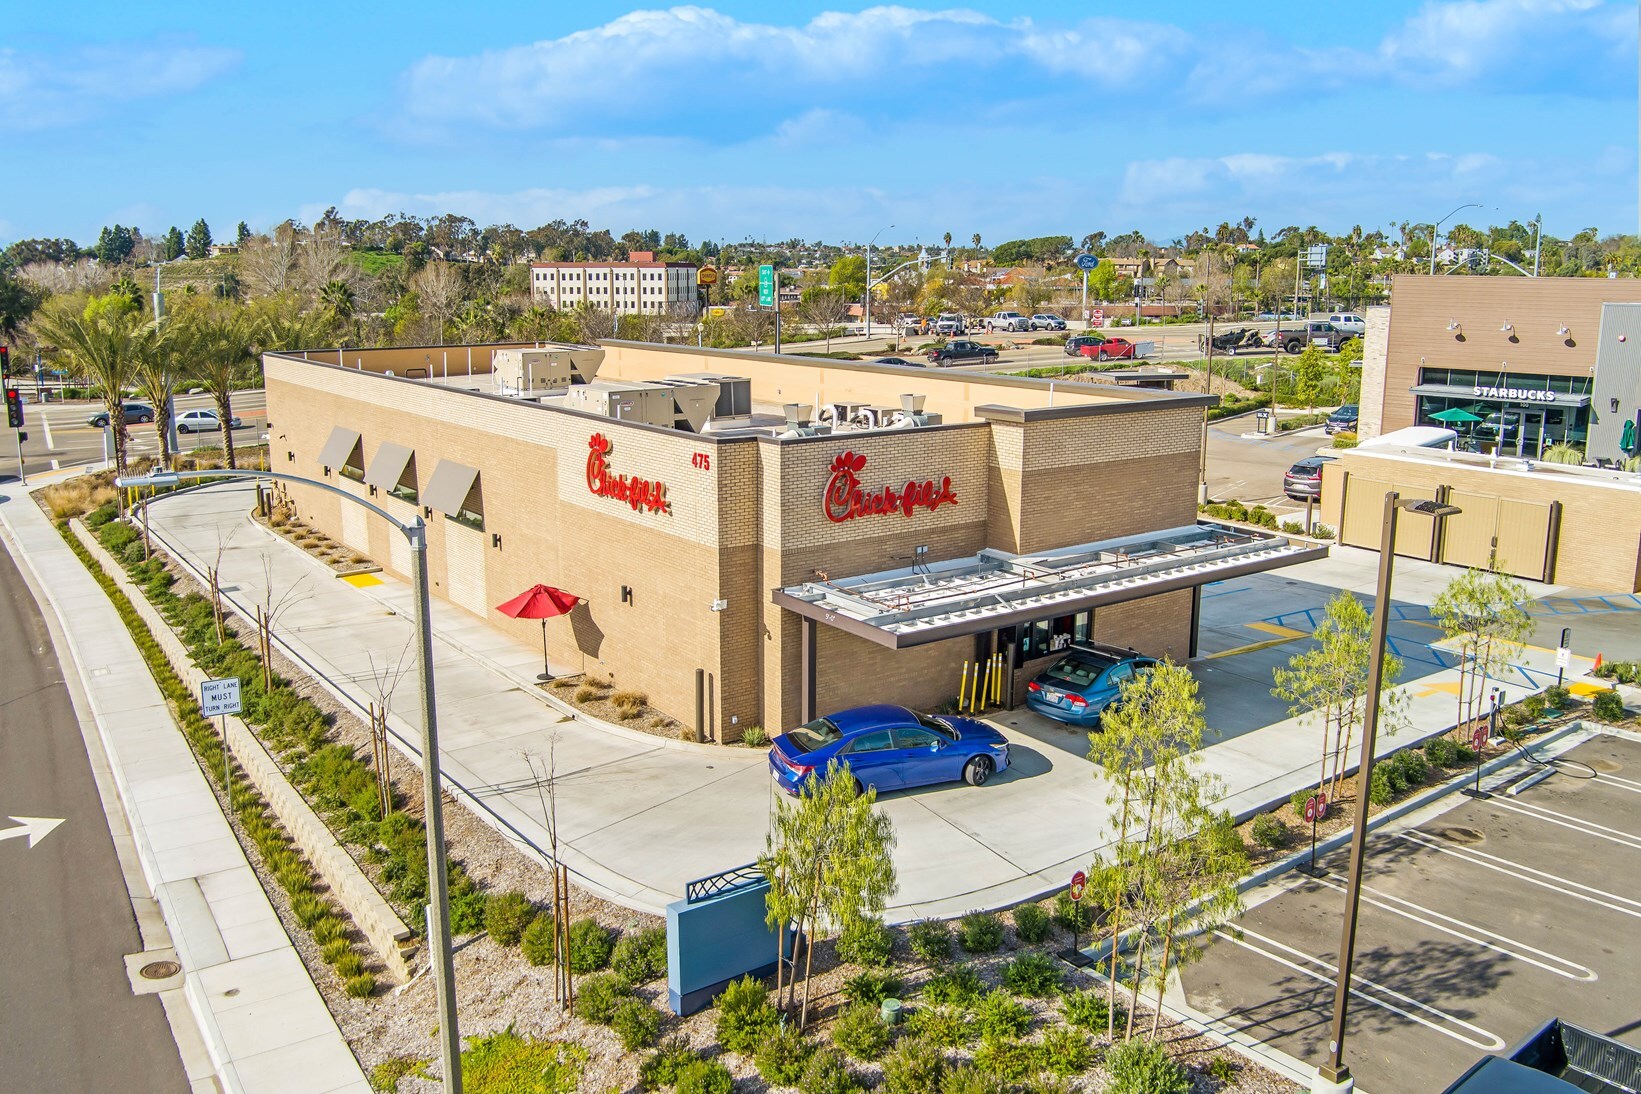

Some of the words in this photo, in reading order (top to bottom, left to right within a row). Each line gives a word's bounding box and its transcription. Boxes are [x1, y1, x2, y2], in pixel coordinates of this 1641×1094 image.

[1081, 257, 1095, 268] Ford
[1473, 386, 1555, 401] STARBUCKS
[691, 452, 710, 471] 475
[203, 684, 219, 692] RIGHT
[223, 681, 238, 690] LANE
[211, 692, 232, 701] MUST
[205, 704, 220, 712] TURN
[223, 702, 240, 710] RIGHT
